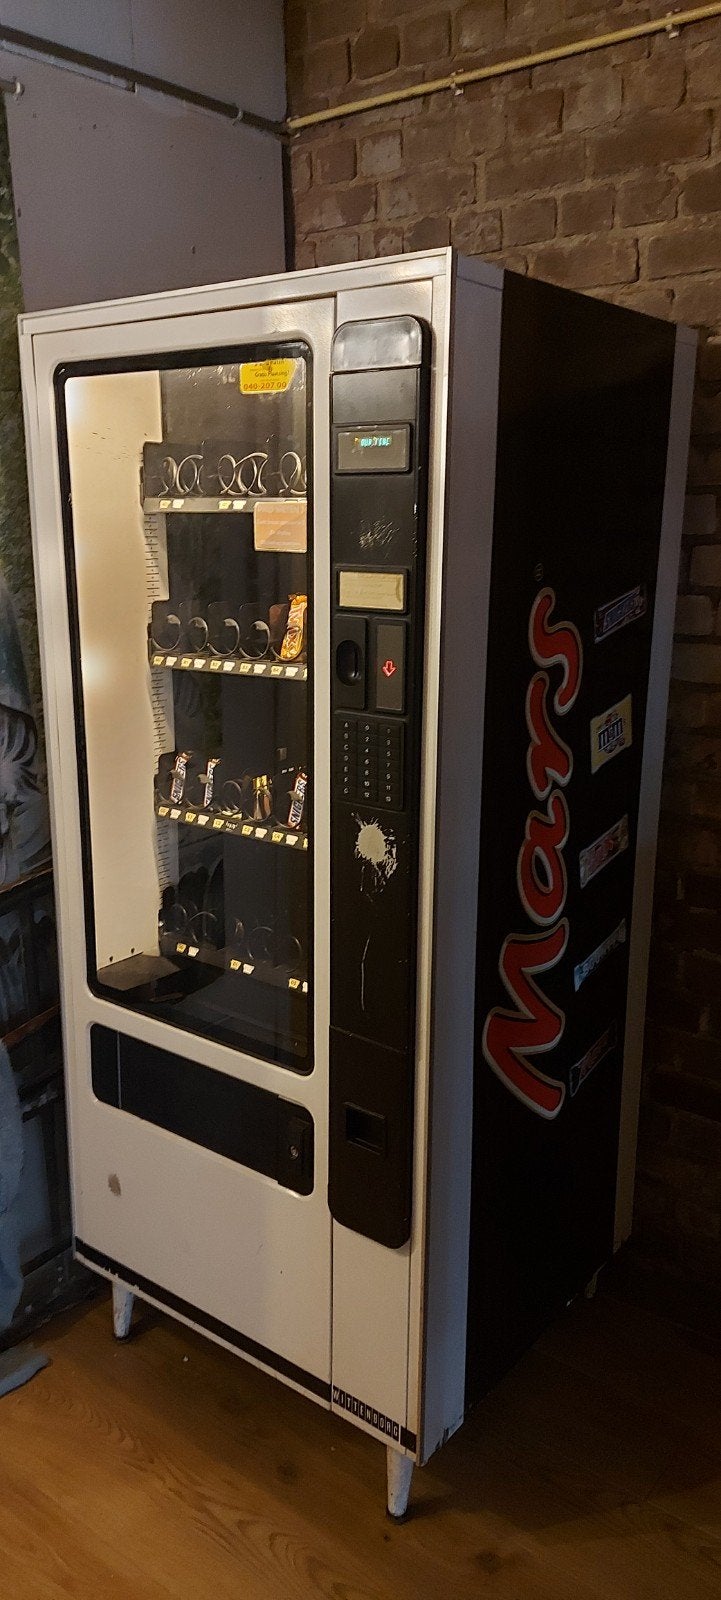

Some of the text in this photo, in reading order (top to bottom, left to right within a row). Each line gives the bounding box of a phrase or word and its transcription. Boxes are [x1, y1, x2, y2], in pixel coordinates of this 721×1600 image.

[290, 779, 307, 827] SNICERS
[482, 586, 584, 1120] Mars
[333, 1389, 398, 1437] WITTENBORG
